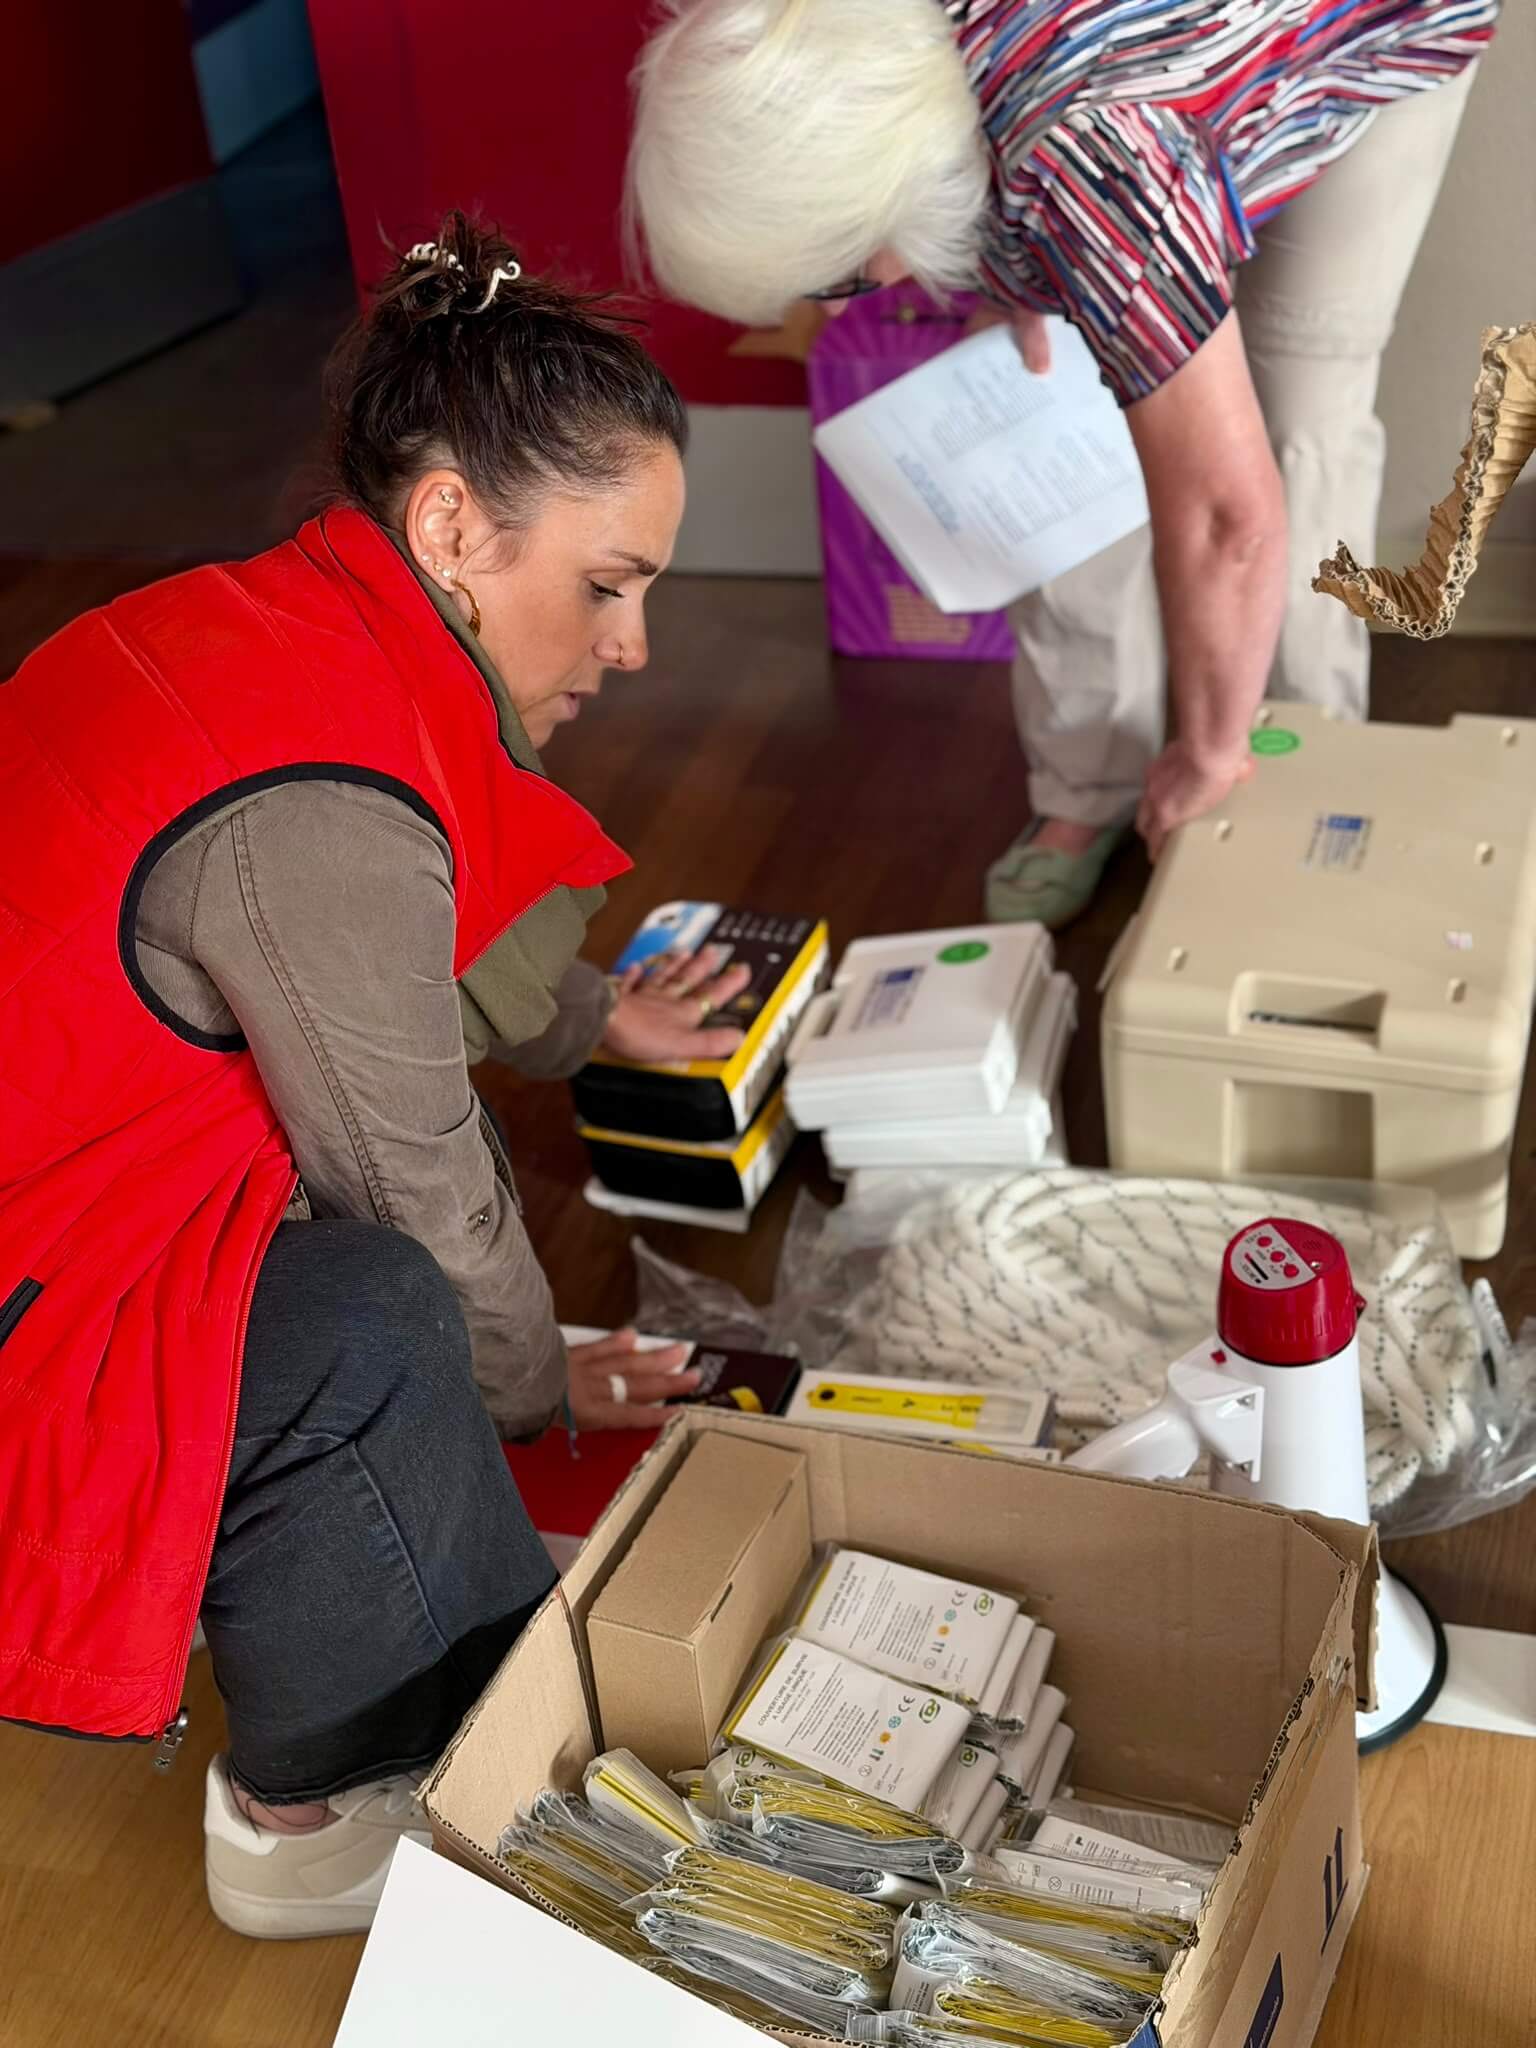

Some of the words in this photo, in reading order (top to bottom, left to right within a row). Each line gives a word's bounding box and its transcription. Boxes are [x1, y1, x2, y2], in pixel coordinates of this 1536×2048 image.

[757, 1684, 787, 1726] COUVERTURE
[784, 1674, 793, 1685] DE
[775, 1692, 792, 1714] USAGE
[895, 1691, 916, 1714] CE
